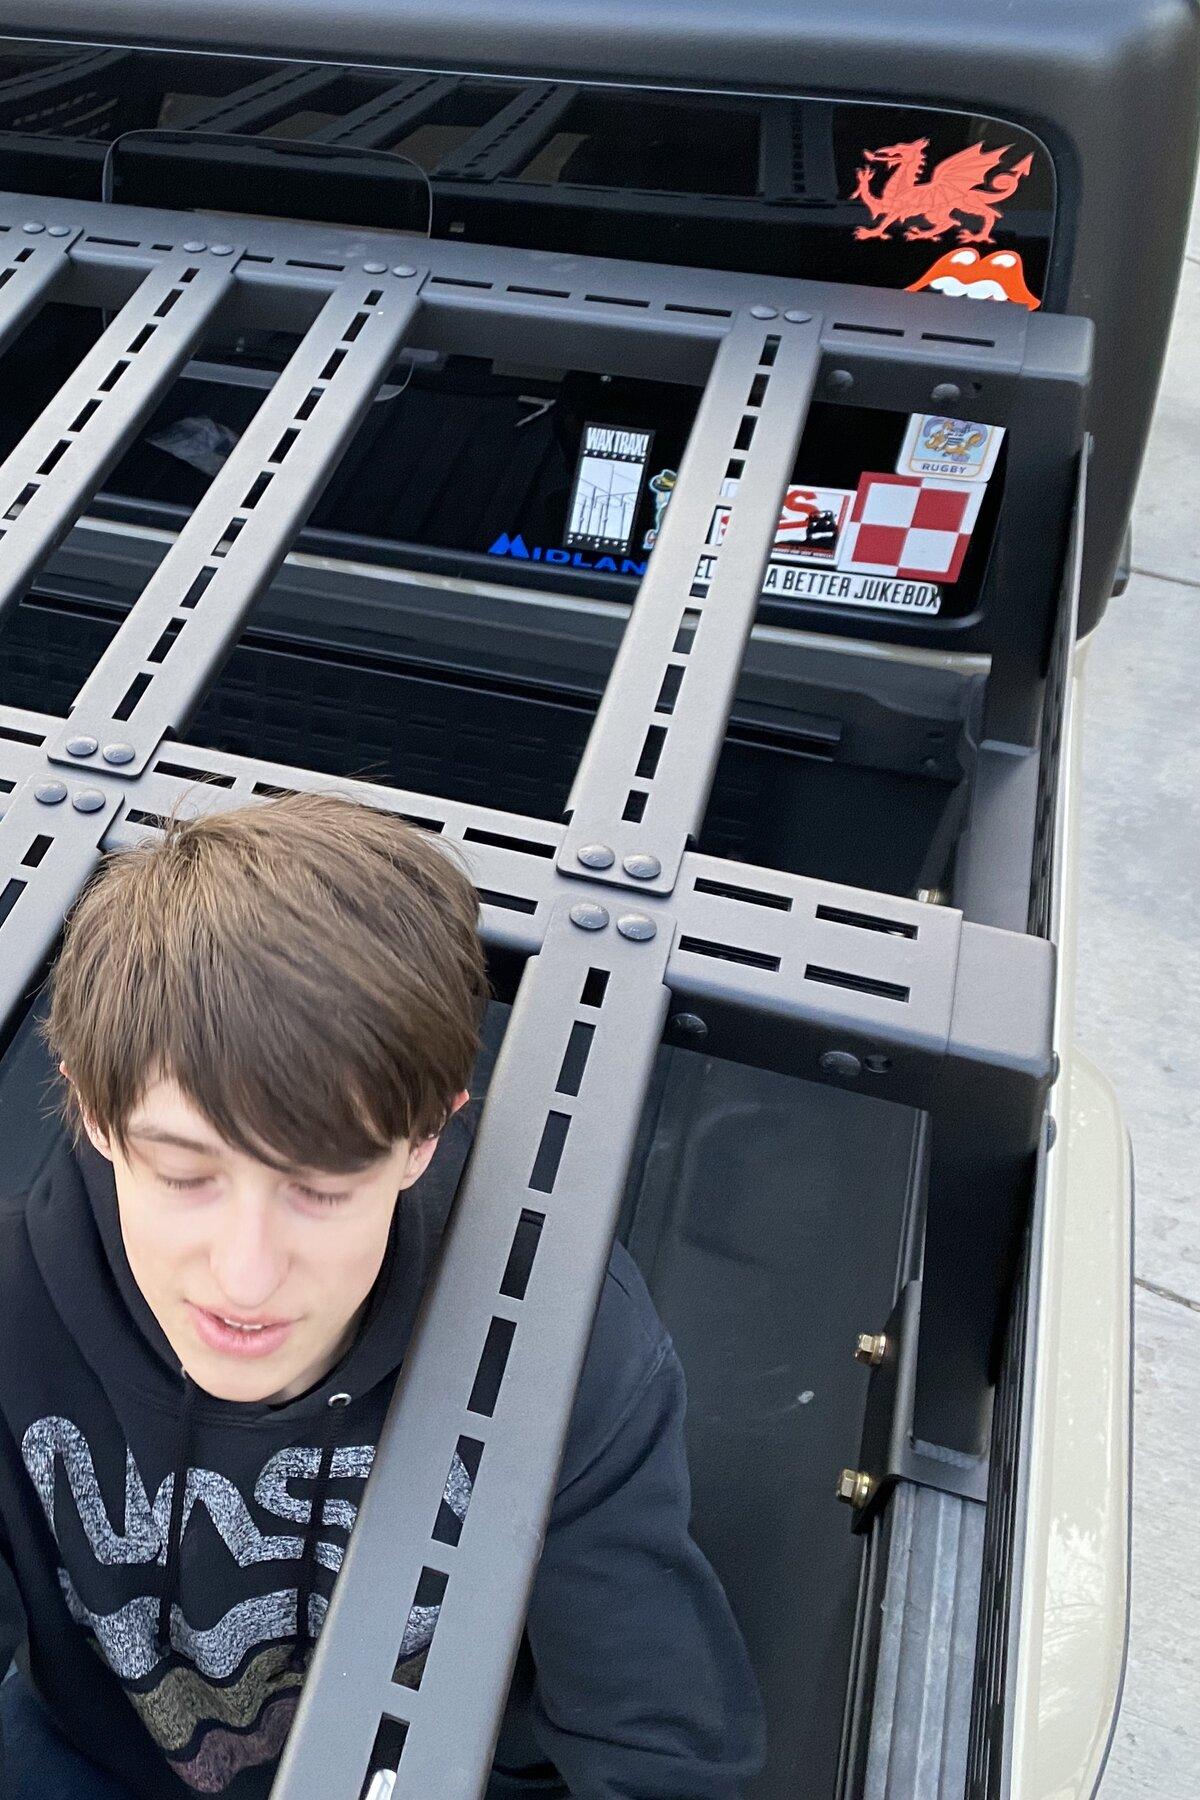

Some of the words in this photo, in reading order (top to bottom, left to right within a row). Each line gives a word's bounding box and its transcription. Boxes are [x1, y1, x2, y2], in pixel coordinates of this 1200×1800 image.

[921, 462, 967, 475] RUGBY
[488, 531, 648, 576] MIDLAN
[765, 567, 779, 588] A
[782, 570, 852, 598] BETTER
[854, 580, 940, 608] JUKEBOX
[22, 1415, 473, 1572] NAS
